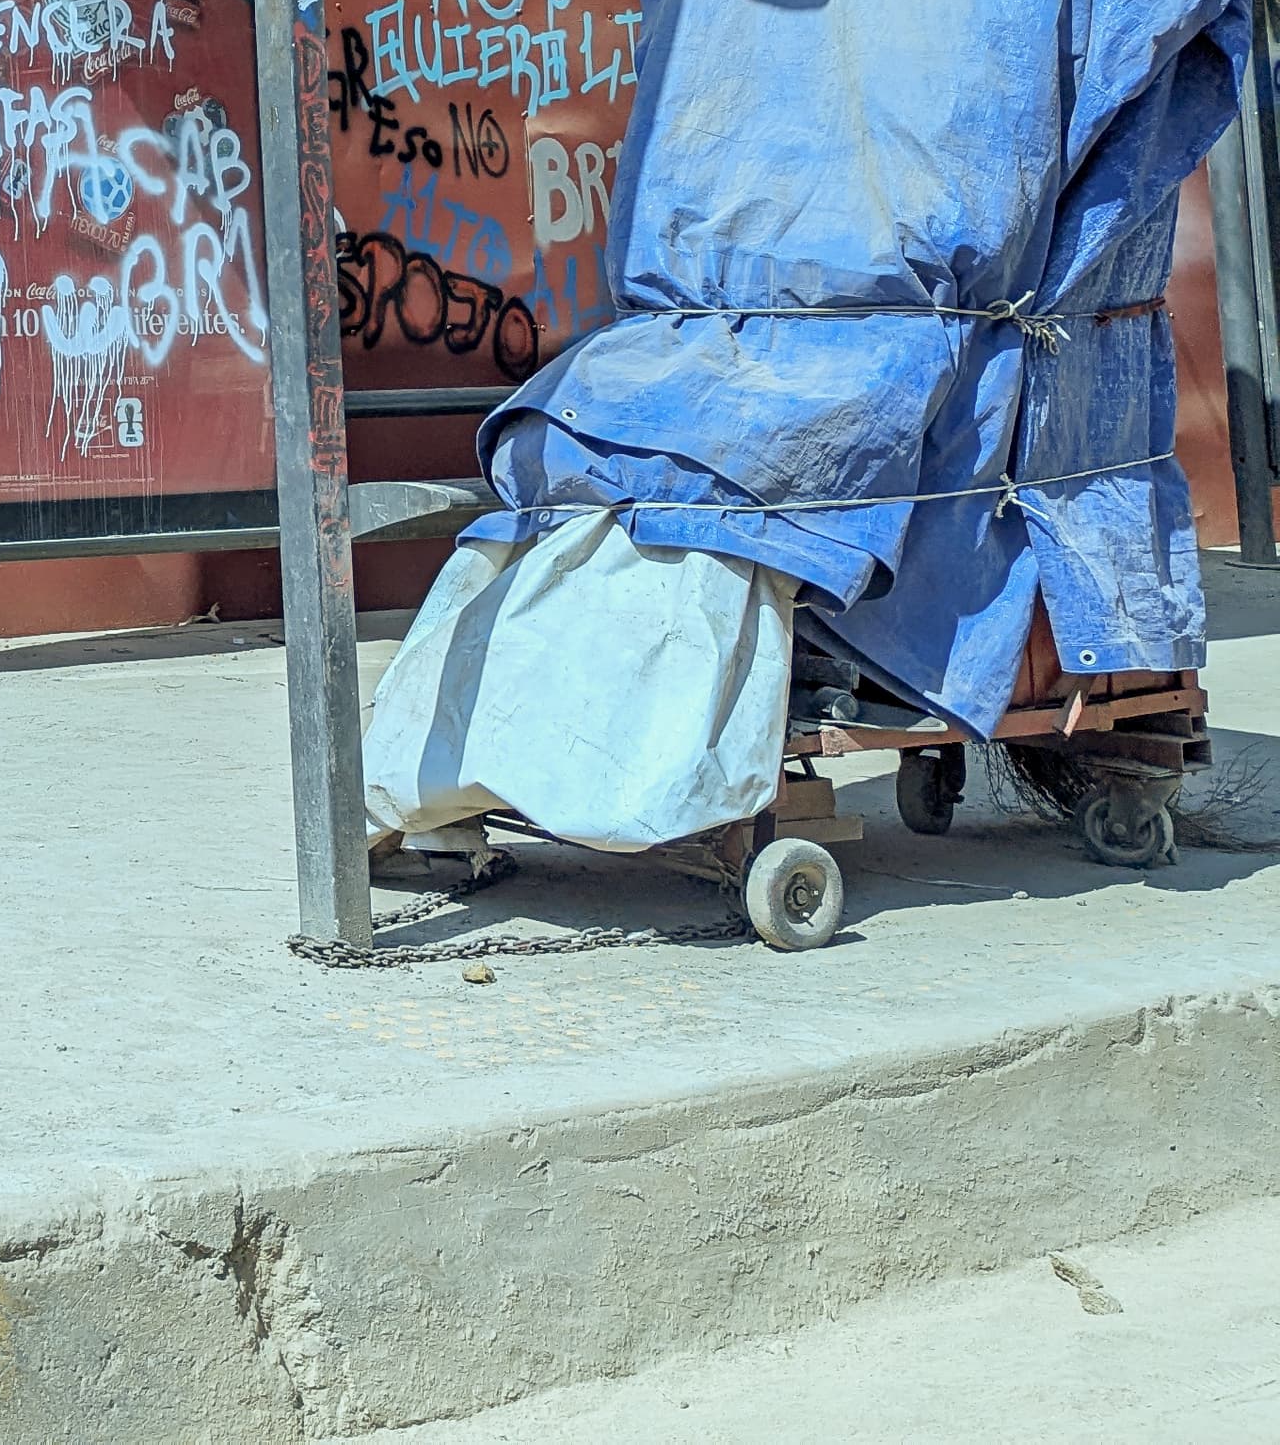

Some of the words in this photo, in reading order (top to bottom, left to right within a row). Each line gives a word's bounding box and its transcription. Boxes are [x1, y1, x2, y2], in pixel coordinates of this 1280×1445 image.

[40, 112, 252, 226] ACAB
[13, 308, 39, 338] 10
[130, 306, 245, 339] iferentes.
